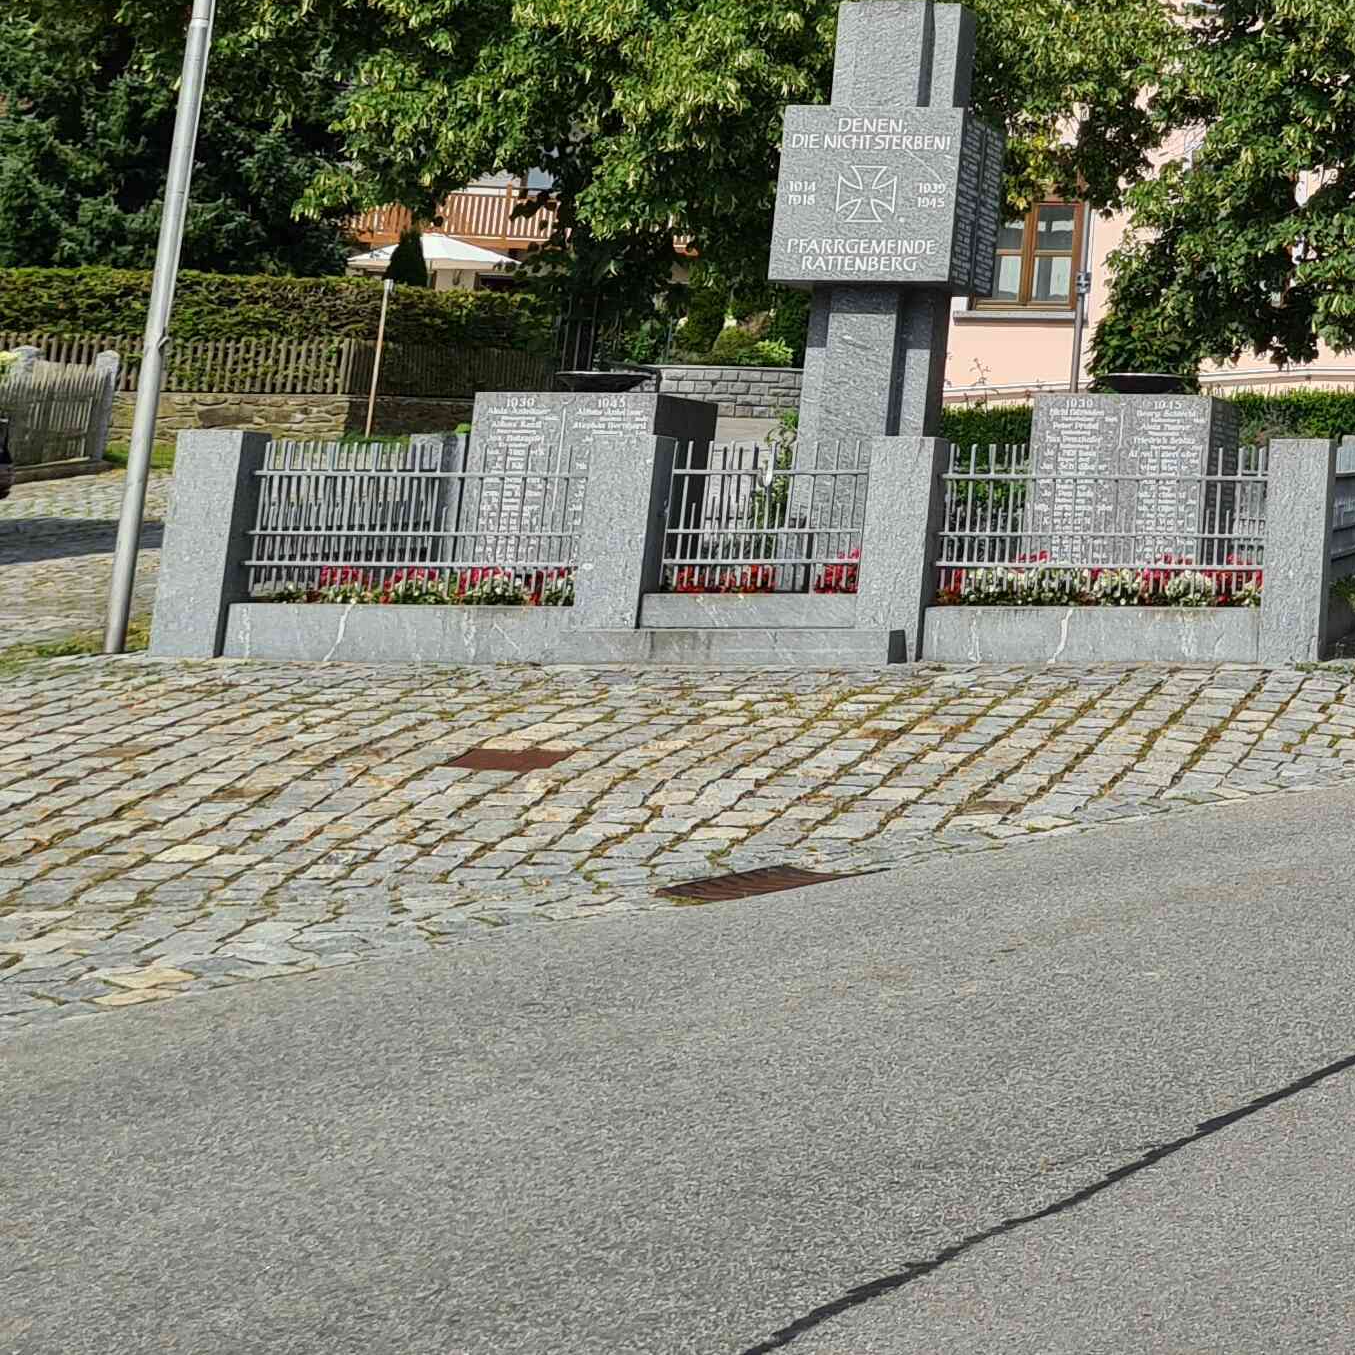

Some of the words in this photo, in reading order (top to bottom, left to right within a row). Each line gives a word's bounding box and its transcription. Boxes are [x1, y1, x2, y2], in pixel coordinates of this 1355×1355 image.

[791, 133, 820, 149] DIE
[823, 134, 872, 150] NICHT
[874, 134, 952, 151] STERBEN!
[788, 180, 817, 192] 1914
[918, 182, 946, 194] 1939
[917, 197, 945, 208] 1945
[786, 238, 938, 255] PFARRGEMEINDE
[802, 255, 918, 272] RATTENBERG
